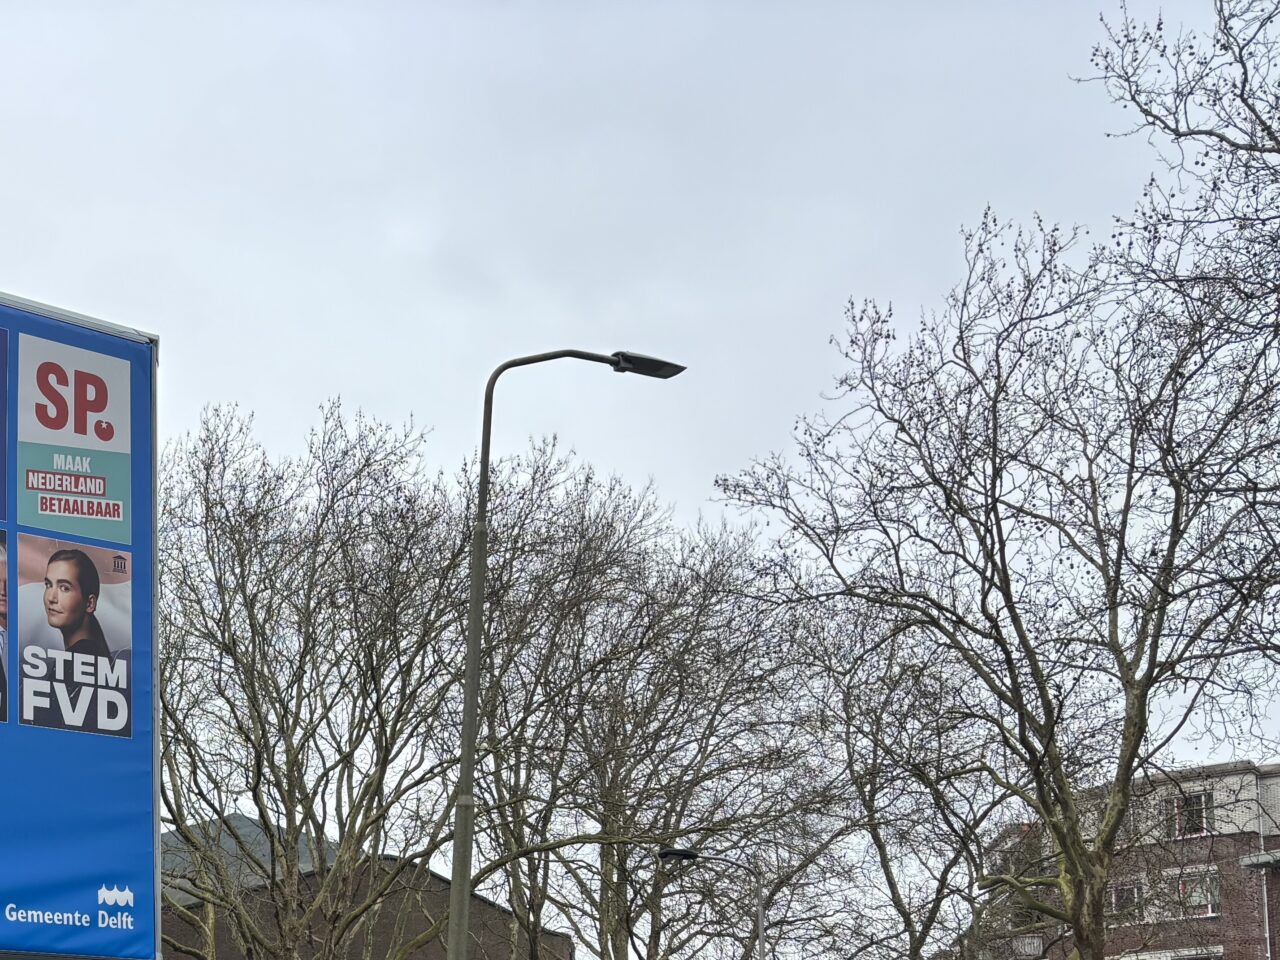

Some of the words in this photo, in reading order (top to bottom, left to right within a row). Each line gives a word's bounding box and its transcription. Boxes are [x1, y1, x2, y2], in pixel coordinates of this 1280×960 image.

[53, 453, 91, 473] MAAK
[28, 471, 104, 495] NEDERLAND
[40, 496, 121, 519] BETAALBAAR
[22, 645, 127, 689] STEM
[22, 677, 128, 731] FVD
[5, 903, 90, 927] Gemeente
[98, 910, 134, 930] Delft
